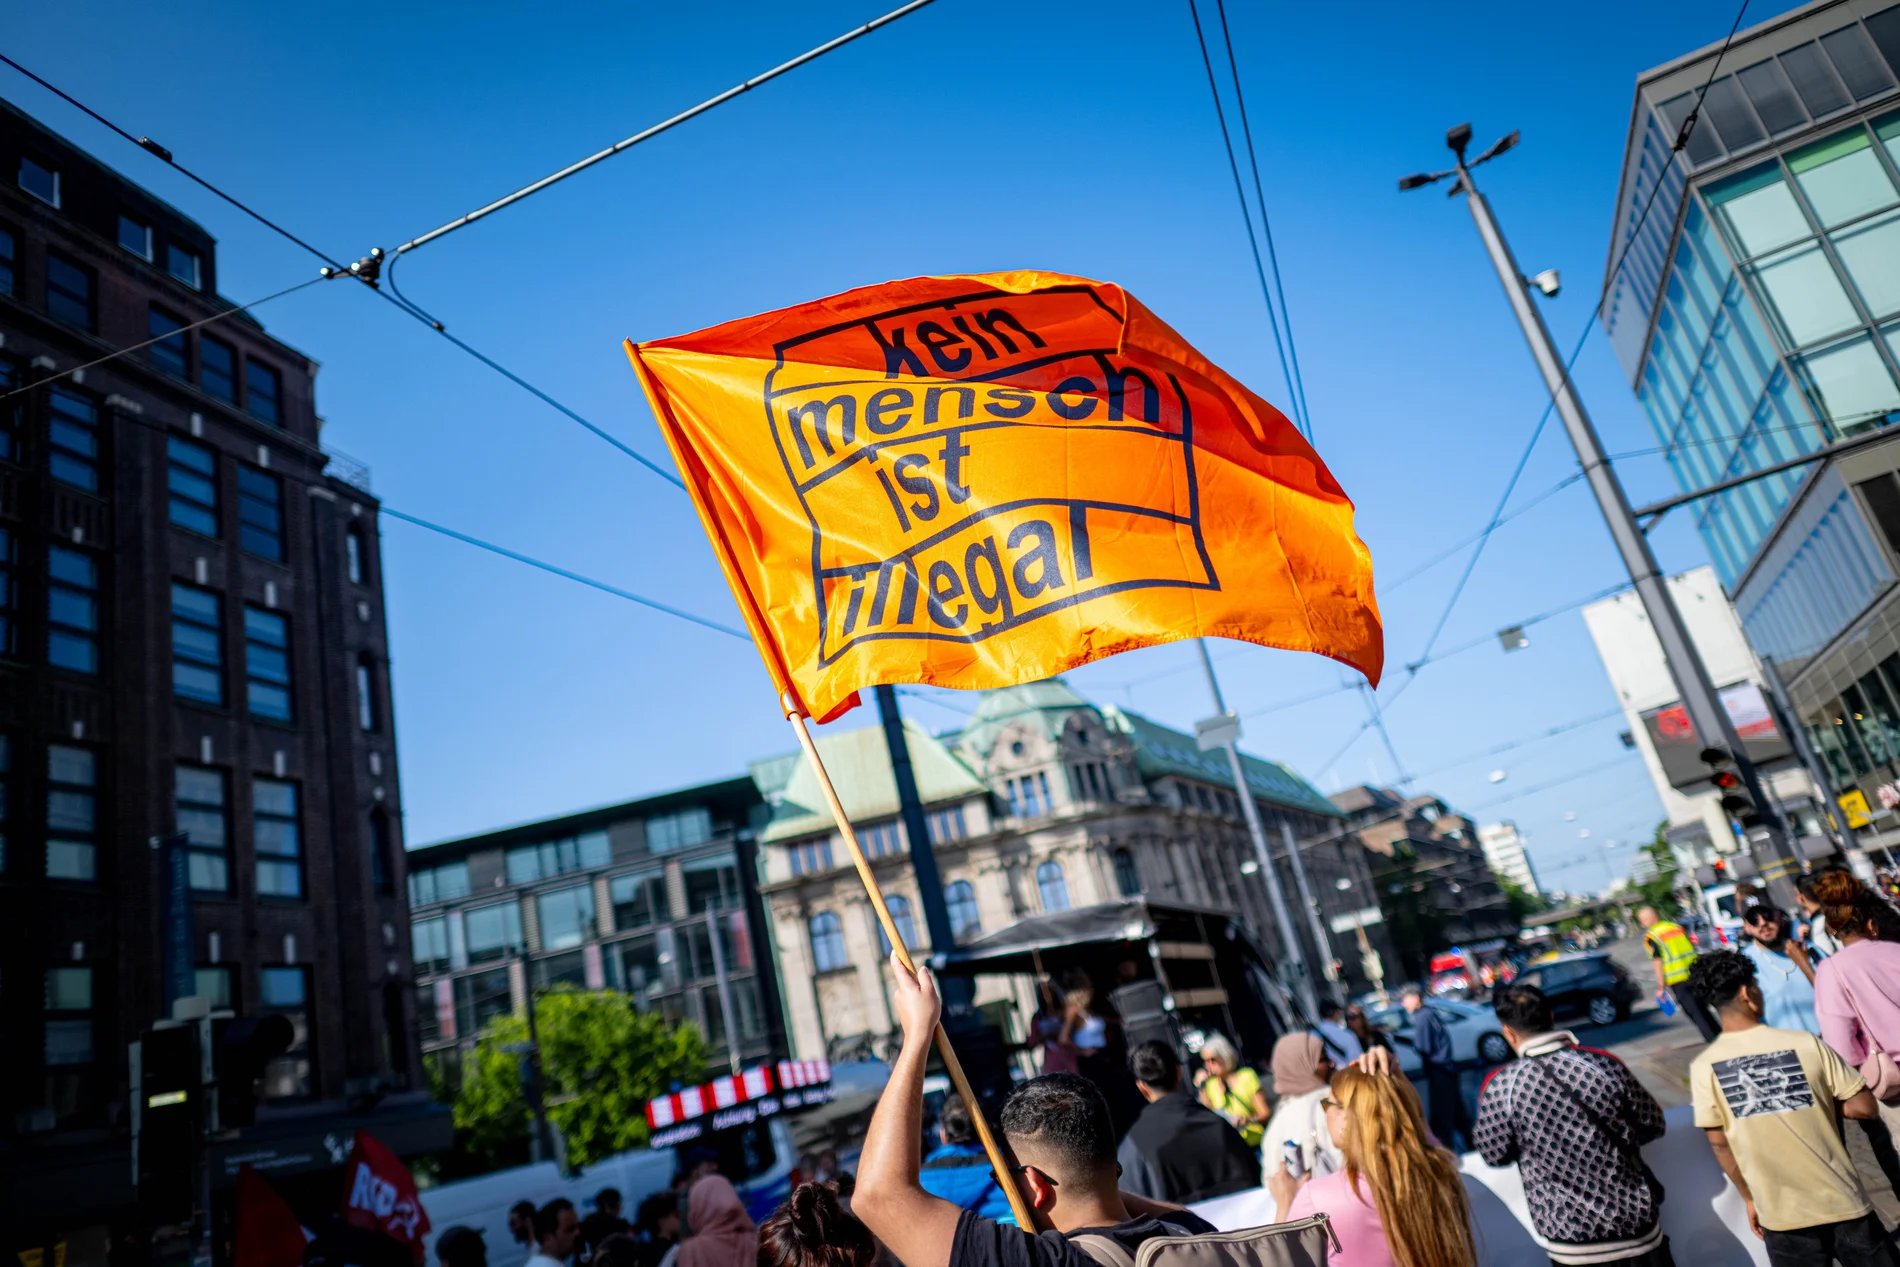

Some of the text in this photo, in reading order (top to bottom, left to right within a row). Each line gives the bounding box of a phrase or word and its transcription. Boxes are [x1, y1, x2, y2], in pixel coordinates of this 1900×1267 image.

[864, 304, 1048, 379] kein
[786, 351, 1161, 470] mensch
[867, 433, 971, 533] ist
[842, 502, 1094, 636] illegal
